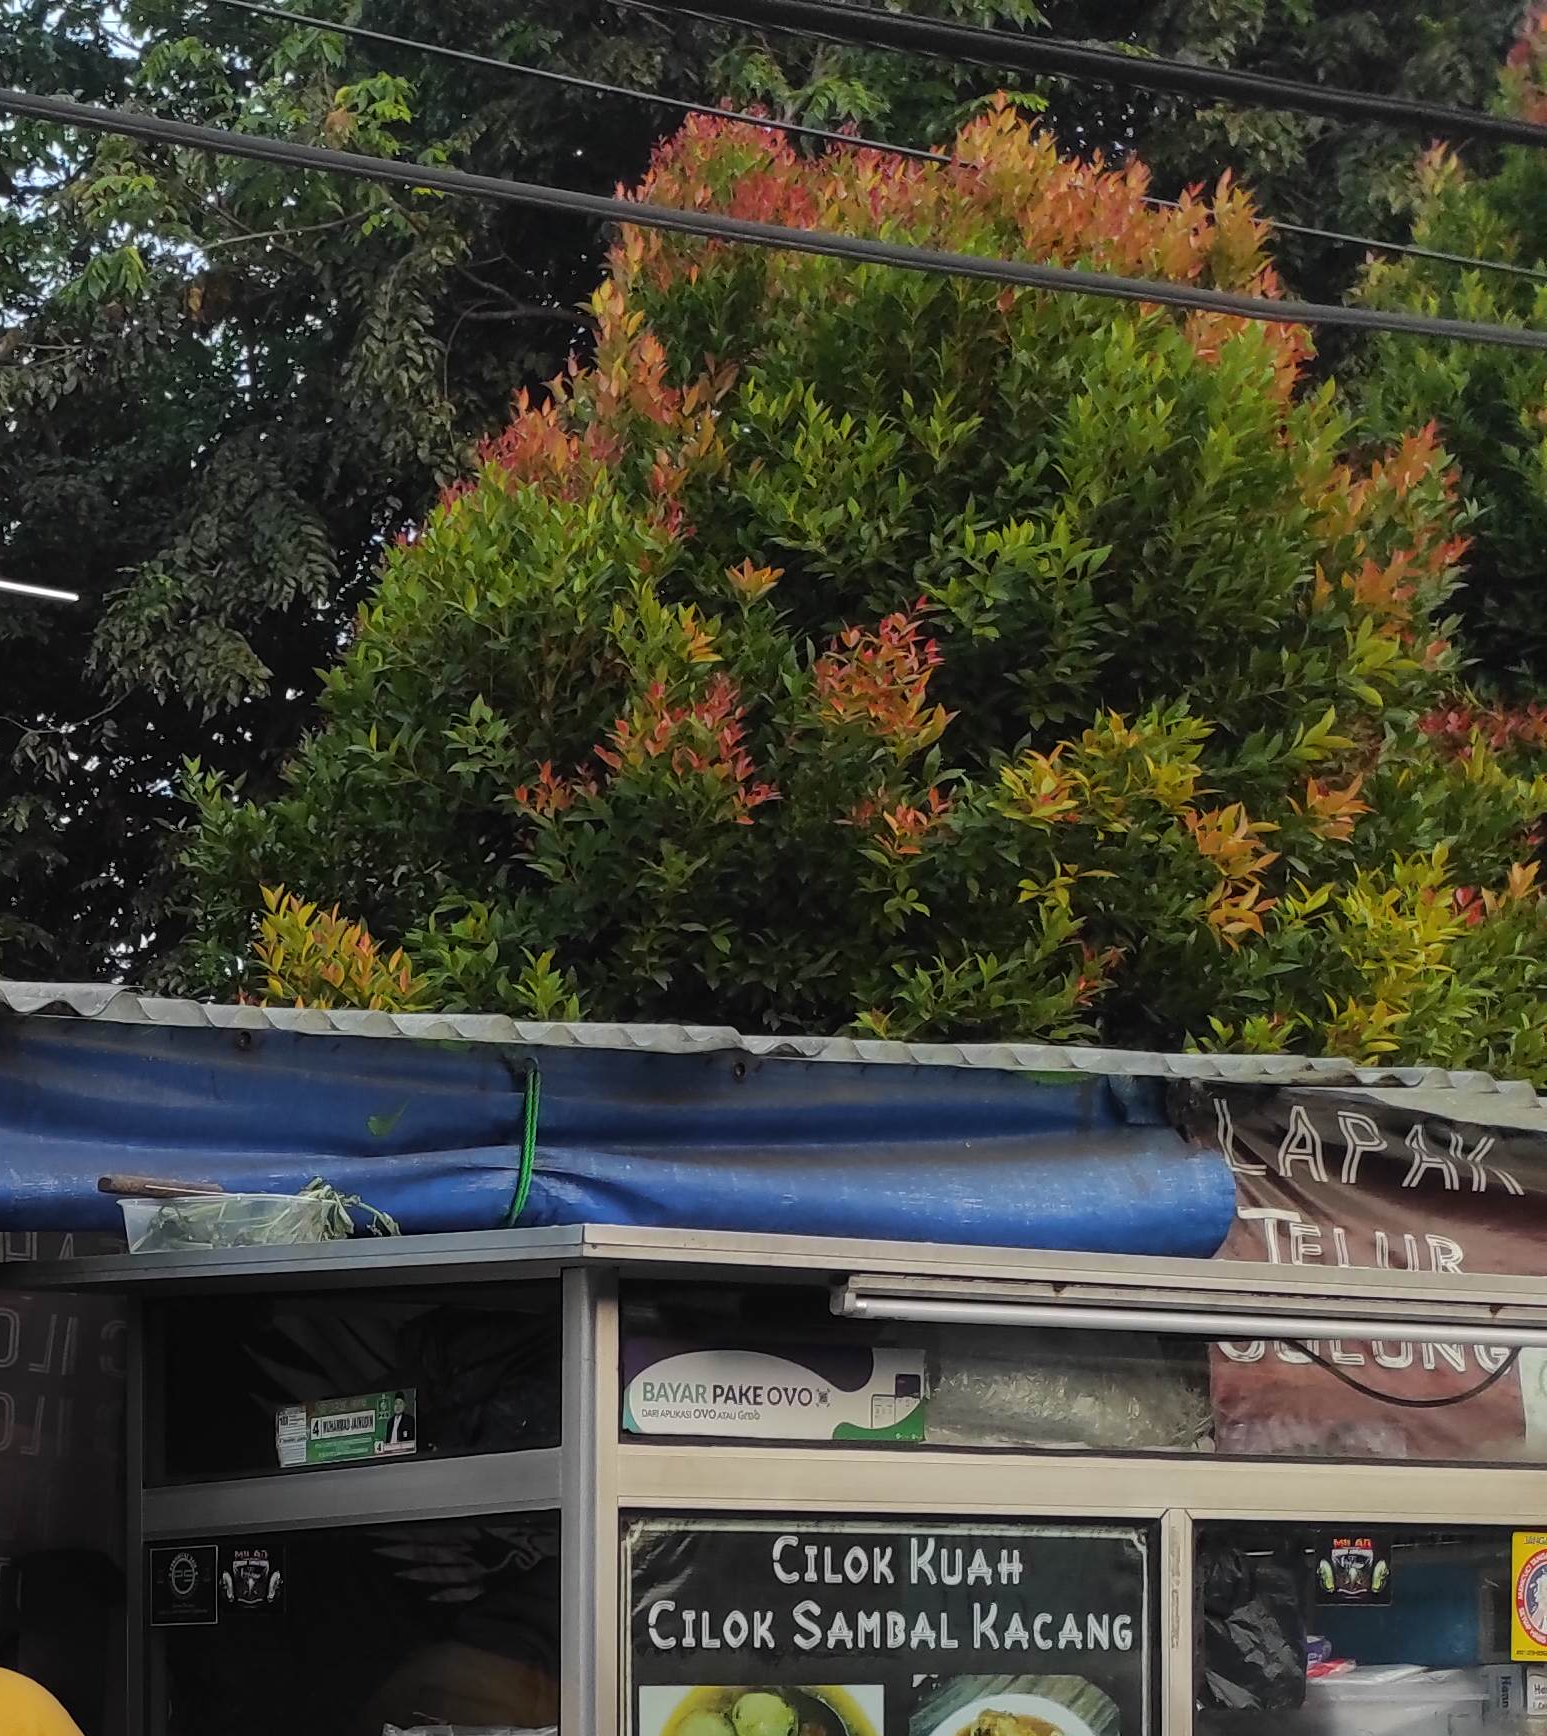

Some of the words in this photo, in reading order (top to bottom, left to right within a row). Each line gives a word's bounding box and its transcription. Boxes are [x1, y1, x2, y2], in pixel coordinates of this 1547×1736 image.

[1213, 1097, 1525, 1196] LAPAK
[1237, 1205, 1465, 1273] TELUR
[641, 1381, 708, 1404] BAYAR
[712, 1384, 764, 1406] PAKE
[767, 1386, 813, 1407] OVO
[641, 1409, 659, 1419] DARI
[660, 1409, 692, 1420] APLIKASI
[693, 1409, 717, 1420] OVO
[717, 1411, 737, 1420] ATAU
